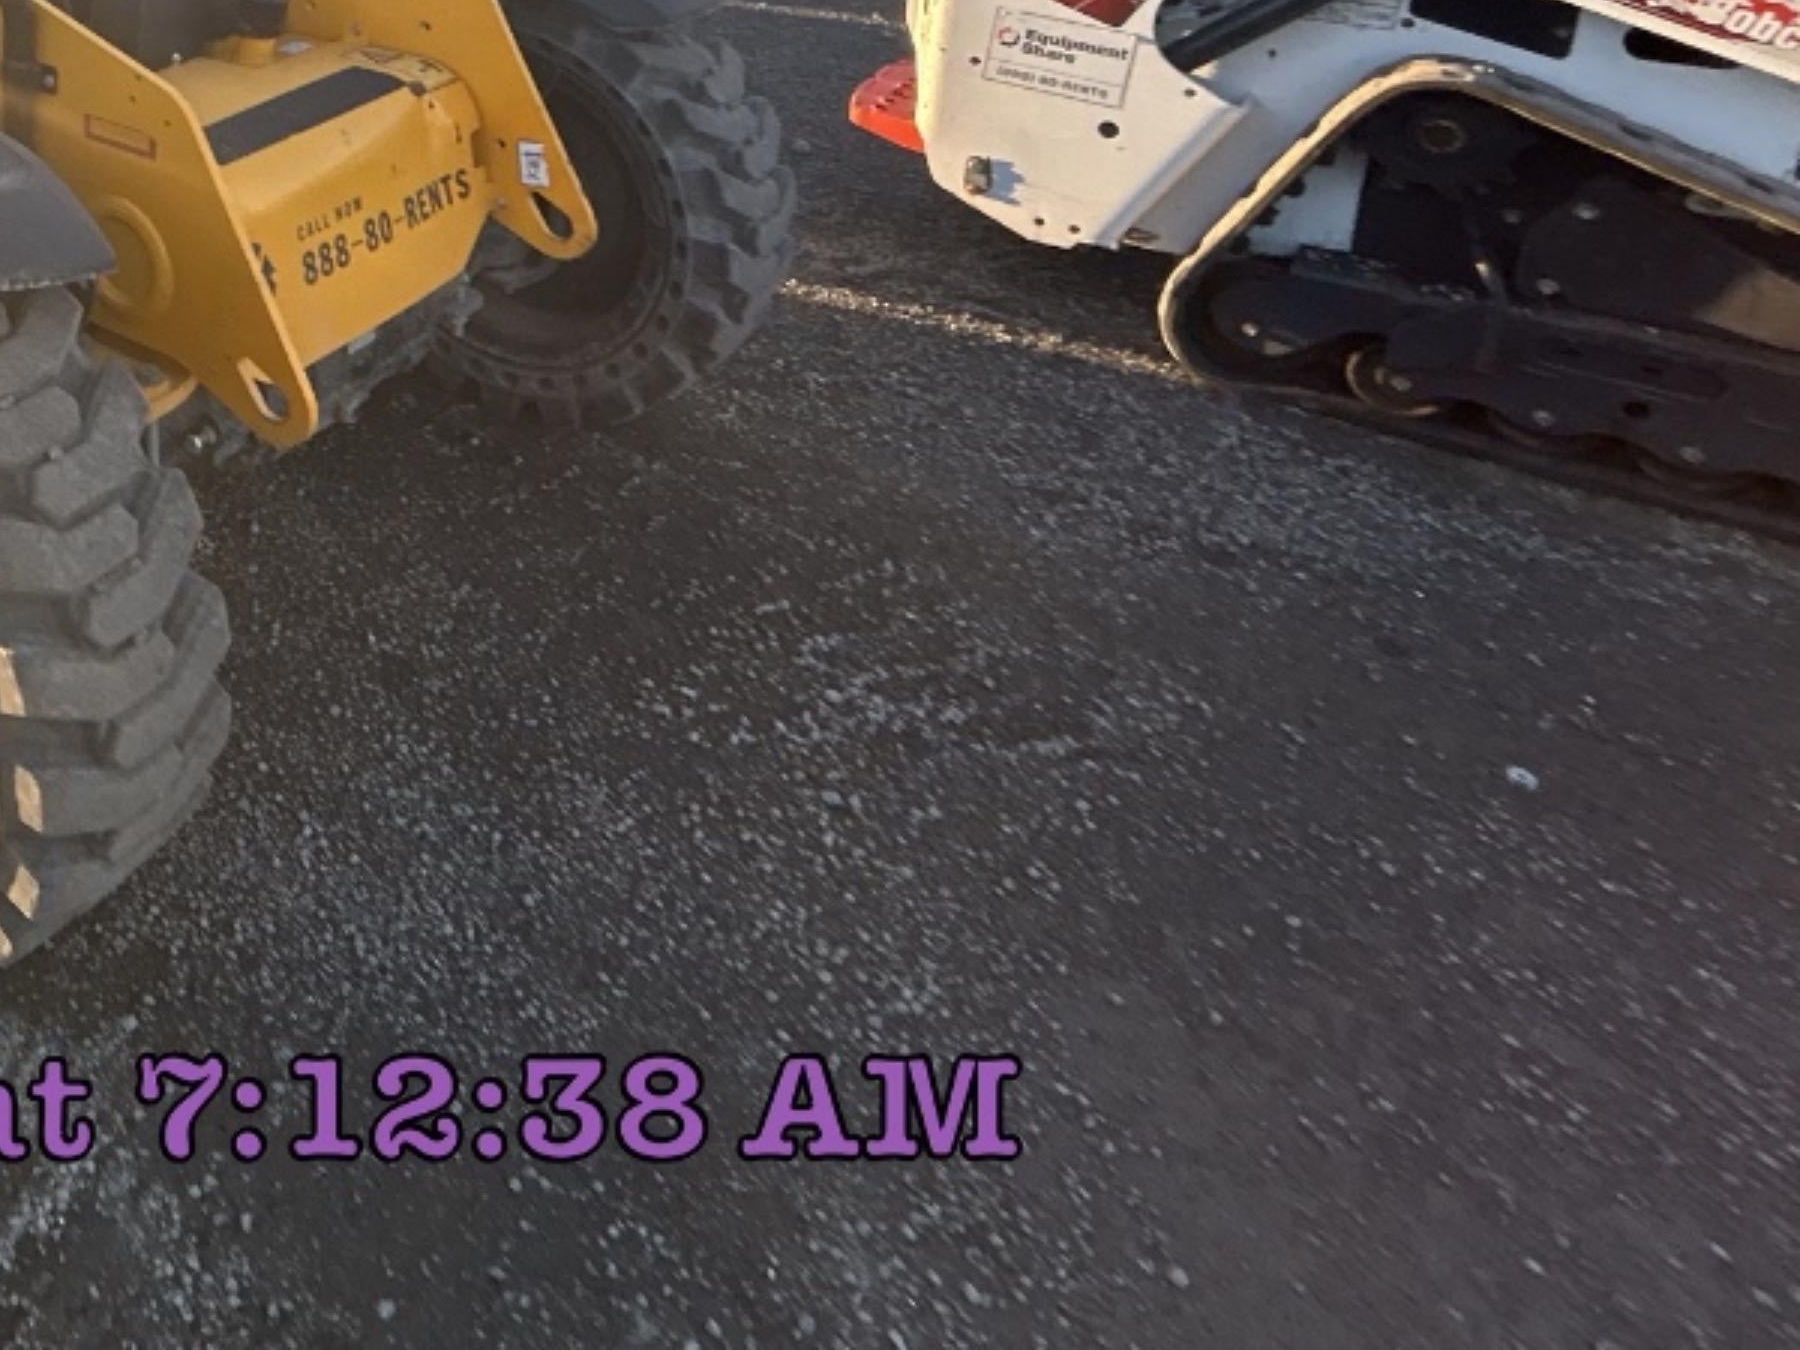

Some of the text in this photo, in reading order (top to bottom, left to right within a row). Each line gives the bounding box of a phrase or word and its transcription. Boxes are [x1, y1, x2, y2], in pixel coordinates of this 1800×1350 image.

[1025, 28, 1129, 61] Equipment
[297, 197, 363, 241] CALL NOW
[303, 167, 471, 286] 888-80-RENTS
